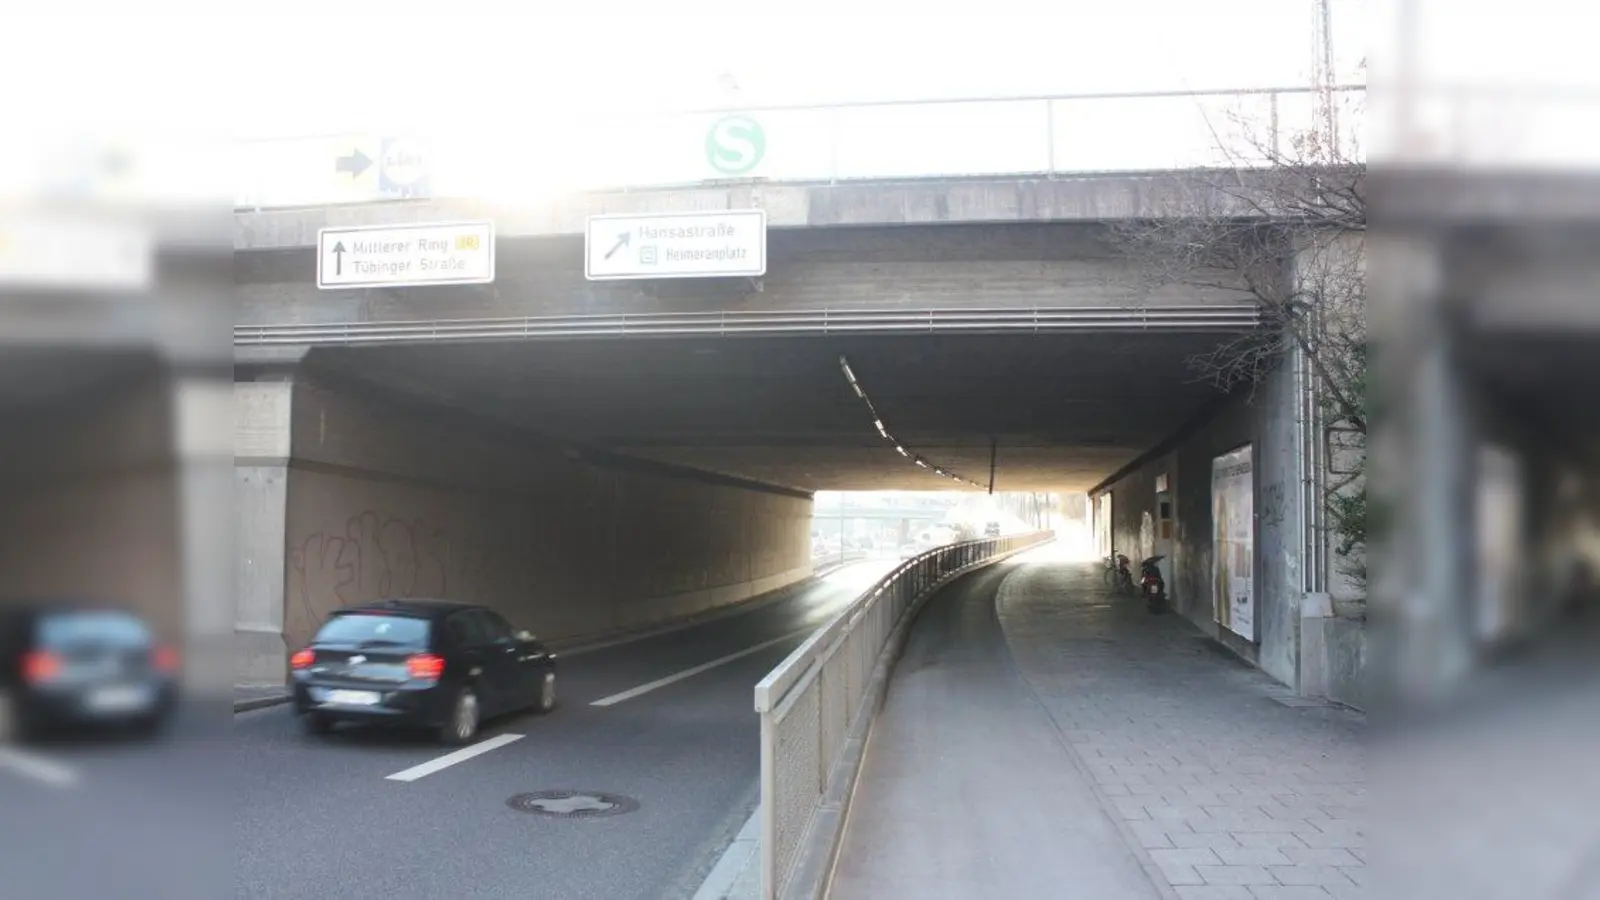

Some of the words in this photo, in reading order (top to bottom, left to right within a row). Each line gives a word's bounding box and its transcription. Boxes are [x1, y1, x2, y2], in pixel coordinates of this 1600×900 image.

[713, 118, 756, 169] S
[639, 223, 735, 240] Hansastraße
[352, 239, 411, 255] Mittlerer
[418, 238, 449, 254] Ring
[665, 246, 747, 262] Heimeranplatz
[352, 259, 412, 275] Tübinger
[420, 256, 467, 272] Straße
